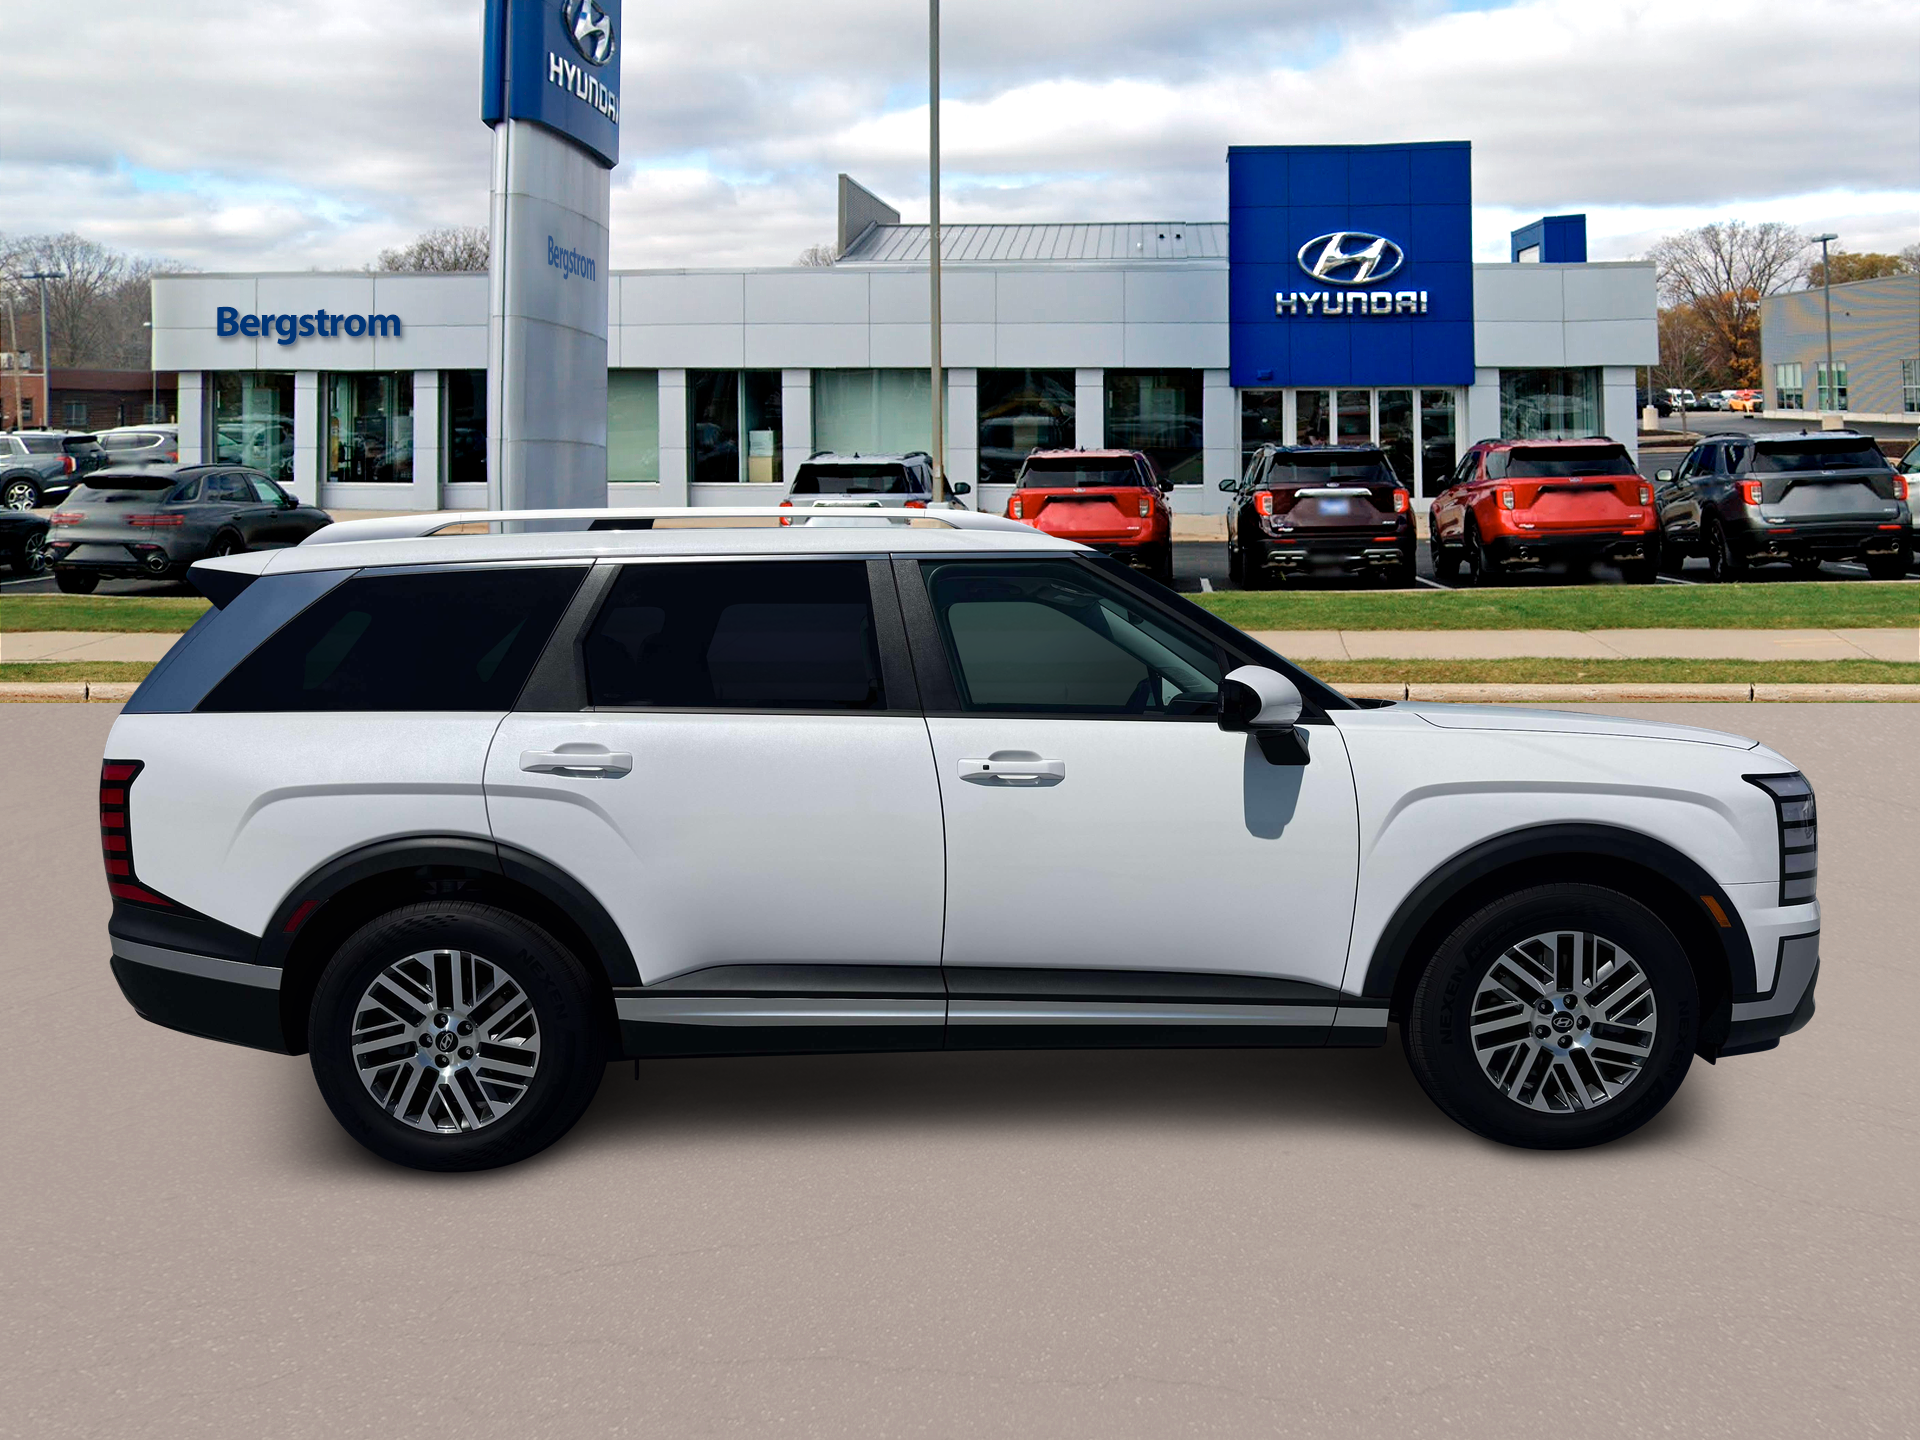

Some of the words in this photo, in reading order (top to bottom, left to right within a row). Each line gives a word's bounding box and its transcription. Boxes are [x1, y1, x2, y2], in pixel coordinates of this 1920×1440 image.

[549, 52, 619, 123] HYUNDAI
[548, 235, 596, 281] Bergstrom
[217, 306, 401, 346] Bergstrom
[1275, 291, 1428, 315] HYUNDAI
[516, 948, 569, 1021] NEXEN
[1439, 965, 1467, 1045] NEXEN
[1663, 1000, 1690, 1078] NEXEN
